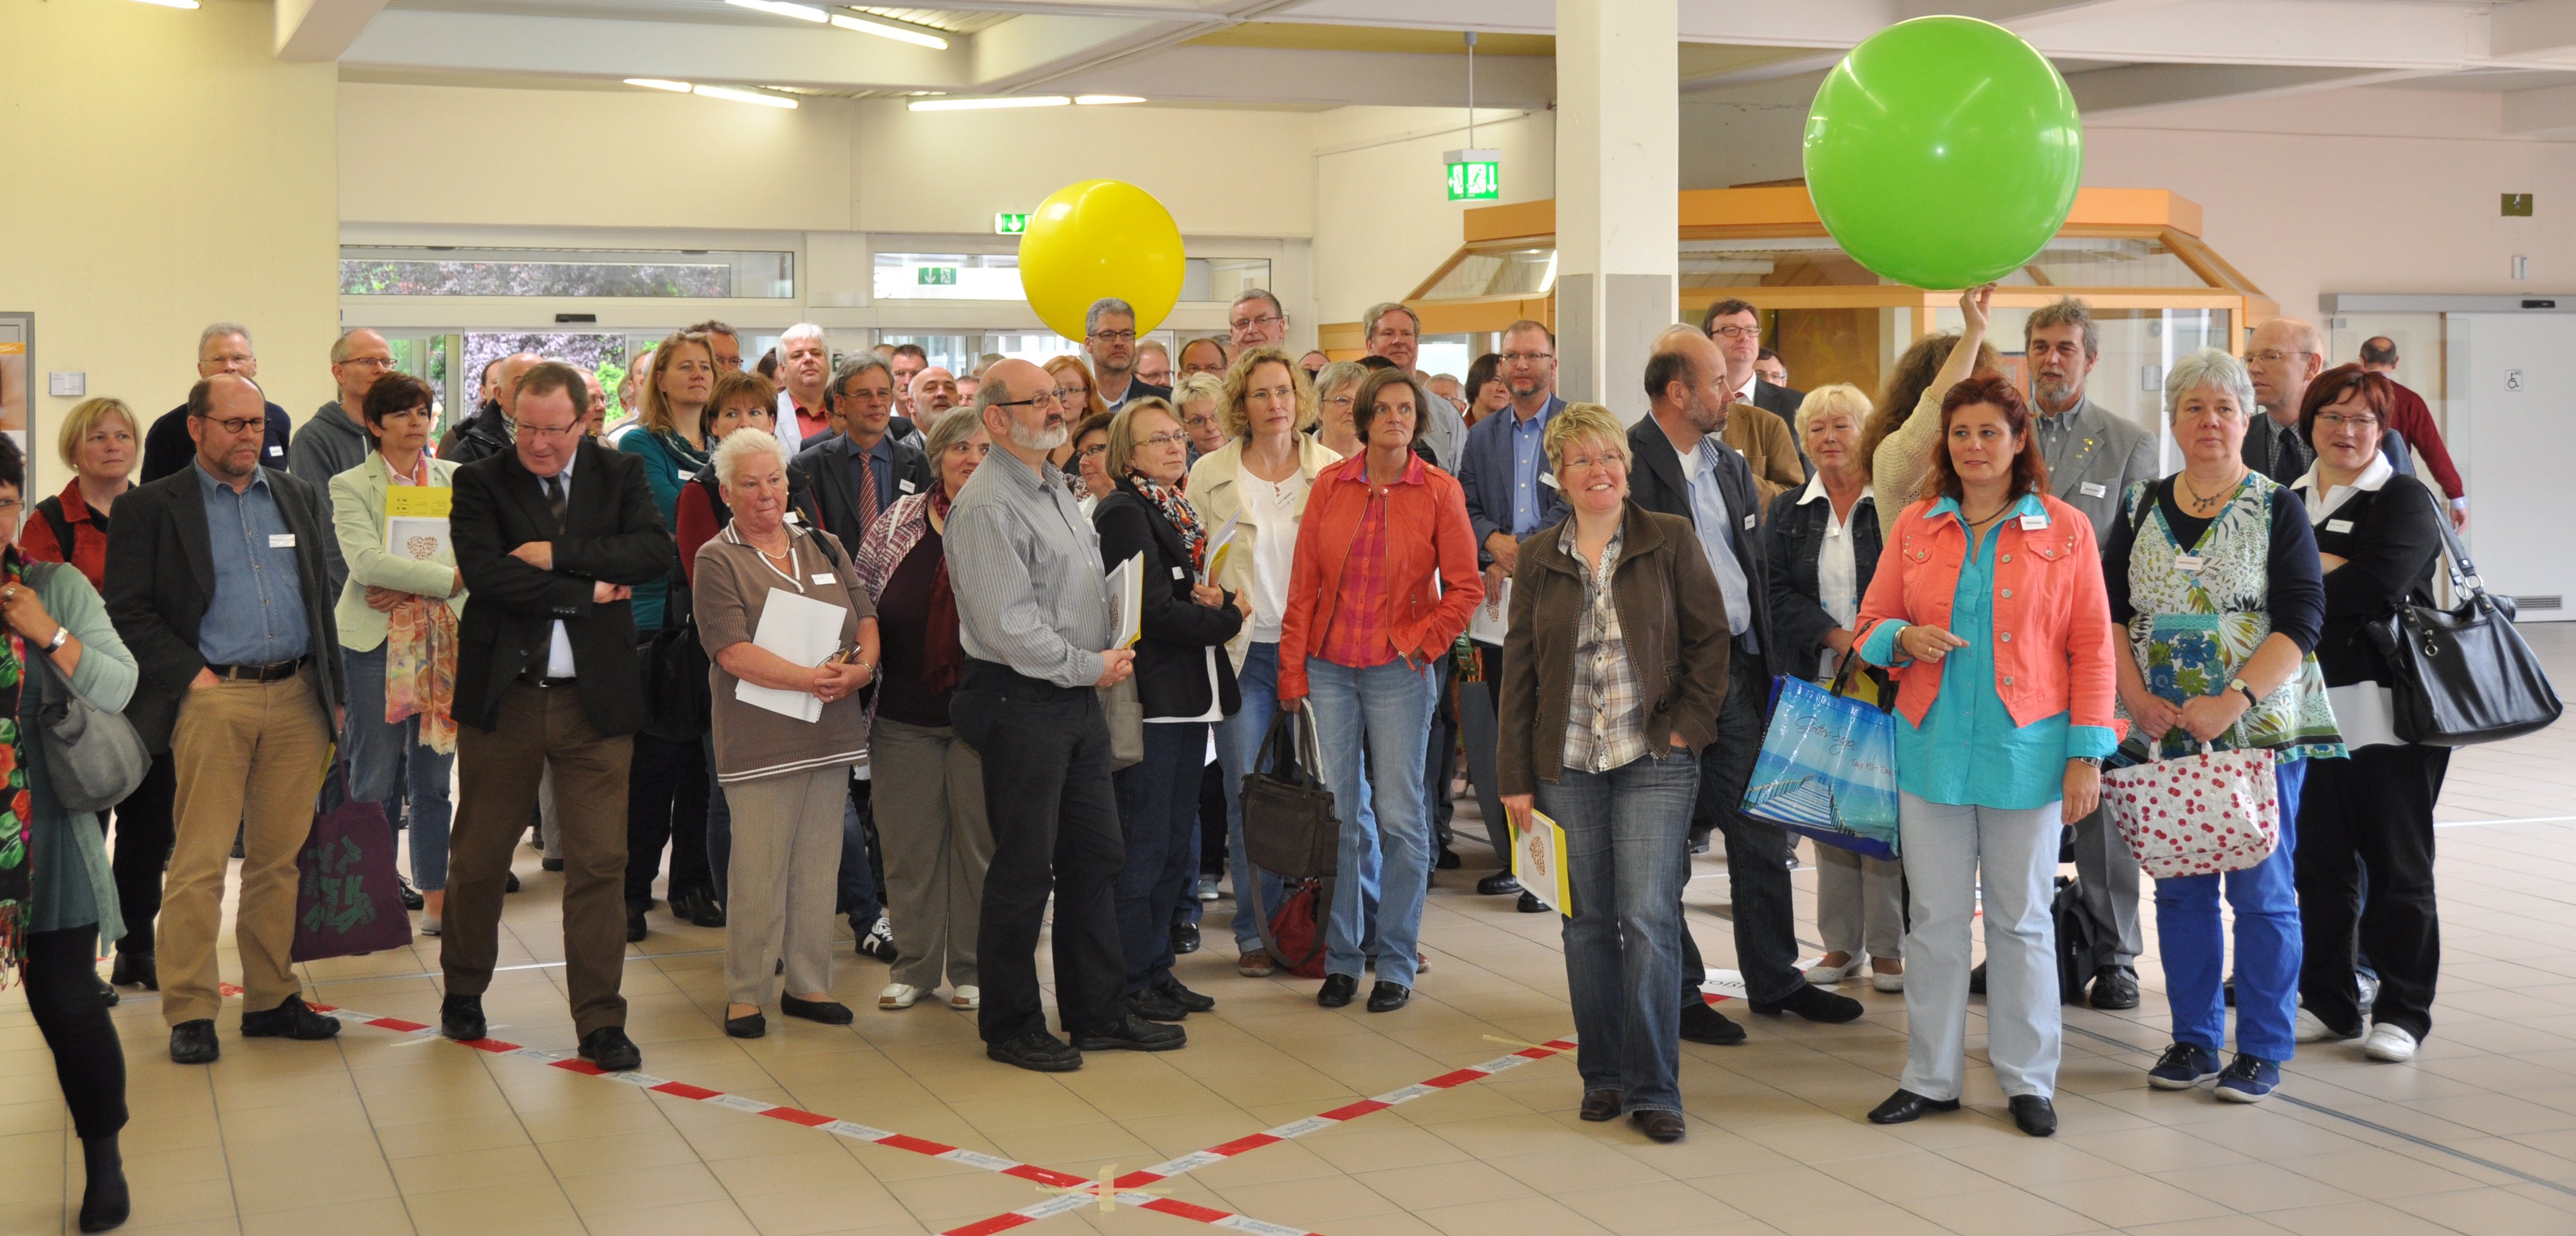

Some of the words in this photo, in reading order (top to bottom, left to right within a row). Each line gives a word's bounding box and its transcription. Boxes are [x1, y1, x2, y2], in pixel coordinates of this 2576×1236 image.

[1796, 716, 1832, 738] Gottes
[1829, 726, 1858, 755] Segen
[1852, 758, 1864, 770] Tag
[1866, 762, 1878, 772] für
